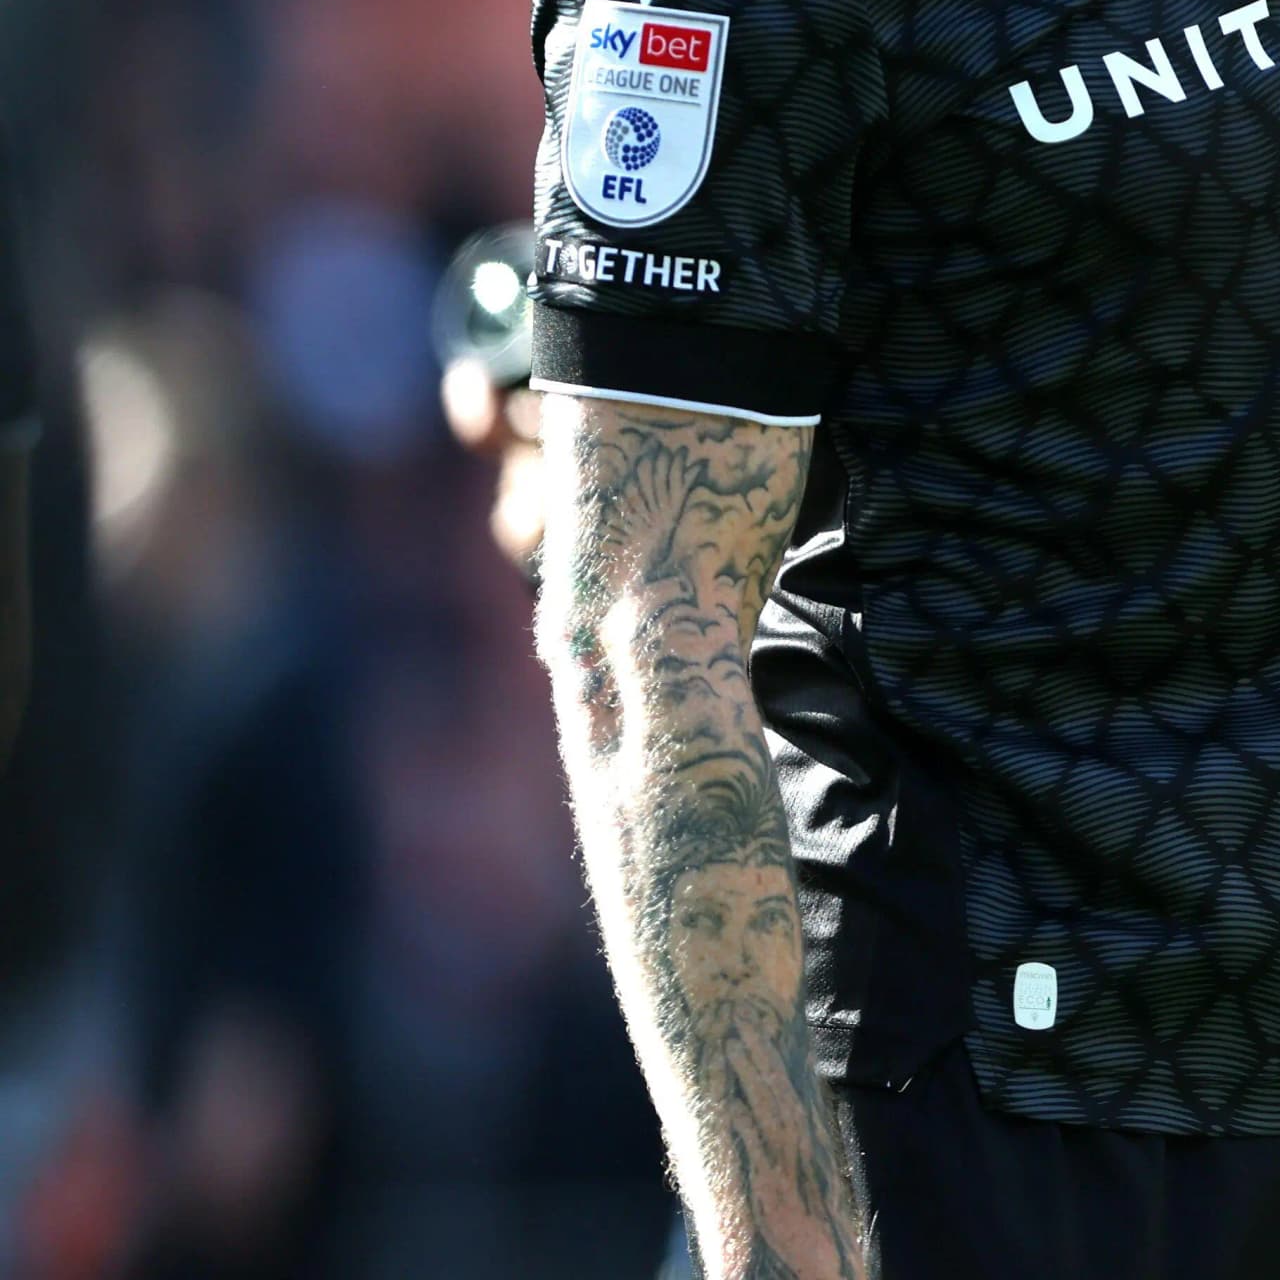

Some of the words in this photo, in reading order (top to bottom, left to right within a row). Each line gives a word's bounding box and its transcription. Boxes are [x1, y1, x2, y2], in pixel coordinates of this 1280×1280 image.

[589, 22, 638, 59] sky
[646, 27, 704, 62] bet
[588, 66, 654, 91] EAGUE
[659, 74, 702, 98] ONE
[601, 174, 648, 205] EFL
[544, 238, 722, 292] TOGETHER
